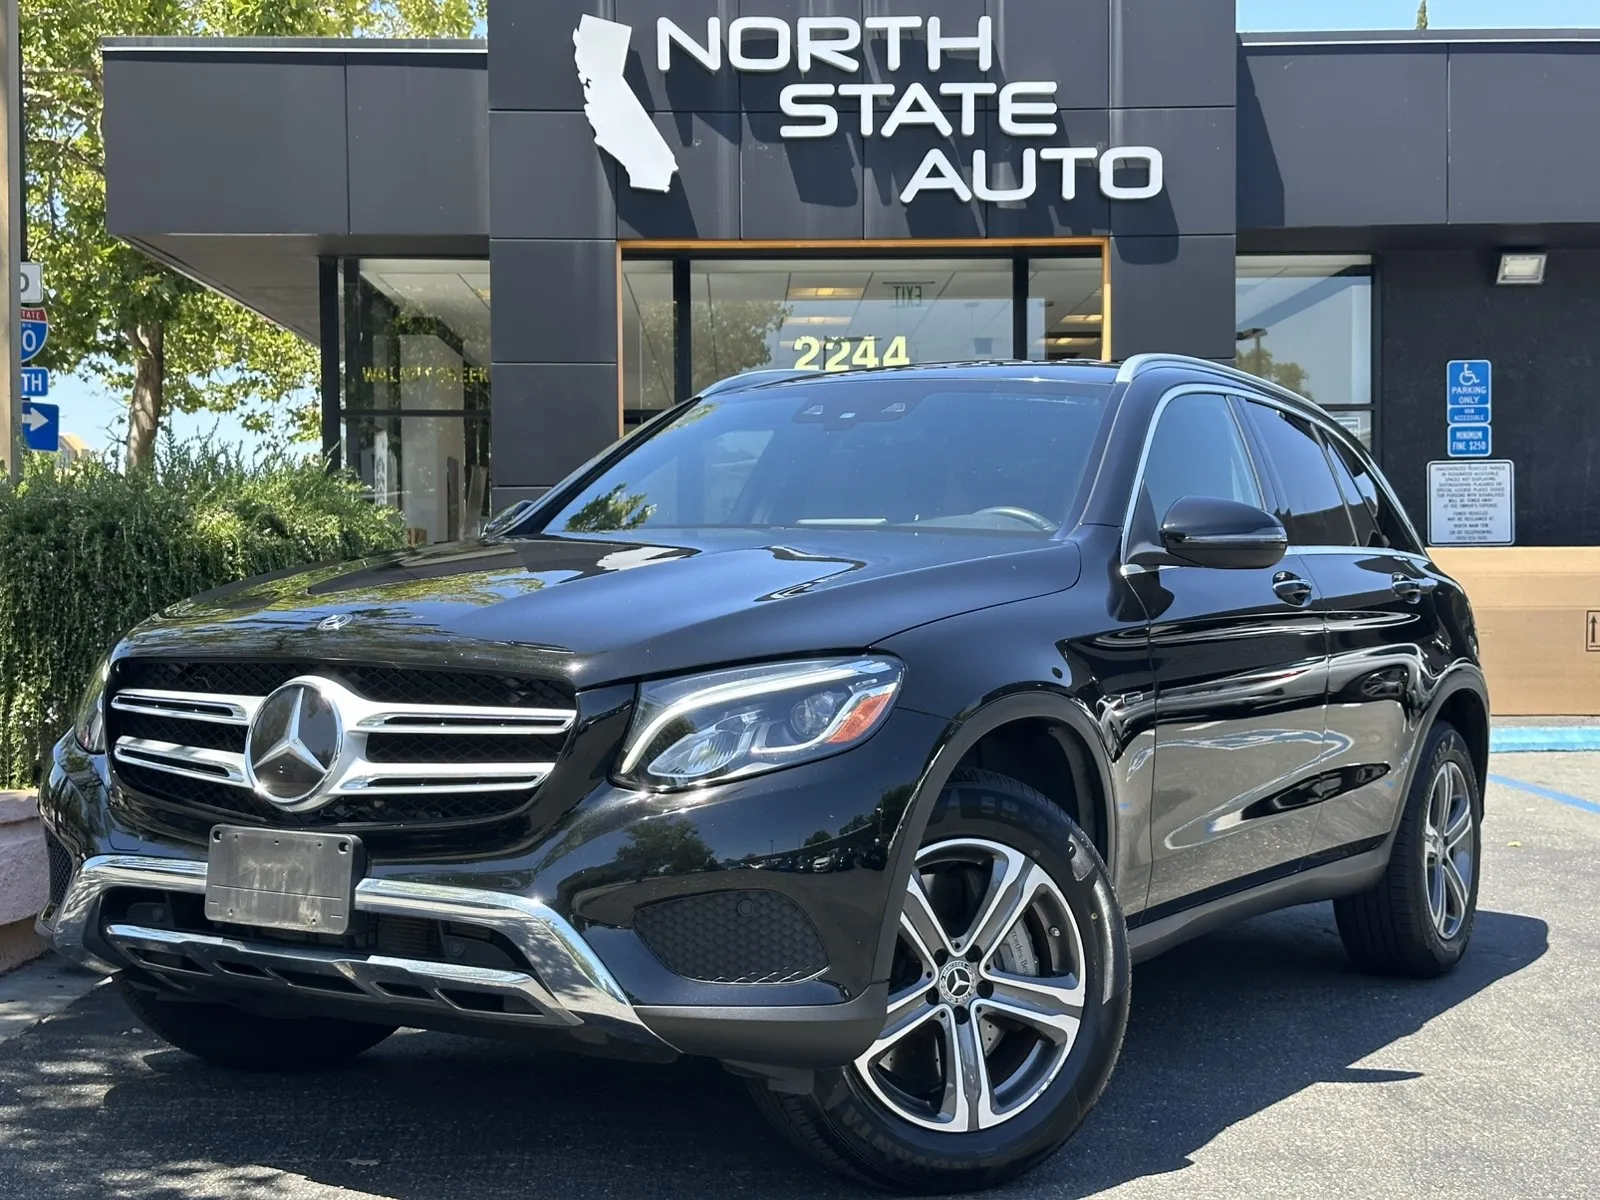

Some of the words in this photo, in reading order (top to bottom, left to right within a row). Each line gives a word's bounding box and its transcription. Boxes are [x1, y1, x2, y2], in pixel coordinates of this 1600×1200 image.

[656, 15, 991, 73] NORTH
[779, 80, 1057, 138] STATE
[900, 146, 1163, 203] AUTO
[793, 335, 911, 371] 2244
[1451, 386, 1487, 394] PARKING
[1458, 396, 1480, 404] ONLY
[1452, 441, 1466, 450] FINE
[1469, 441, 1487, 450] $250
[1456, 431, 1482, 440] MINIMUM
